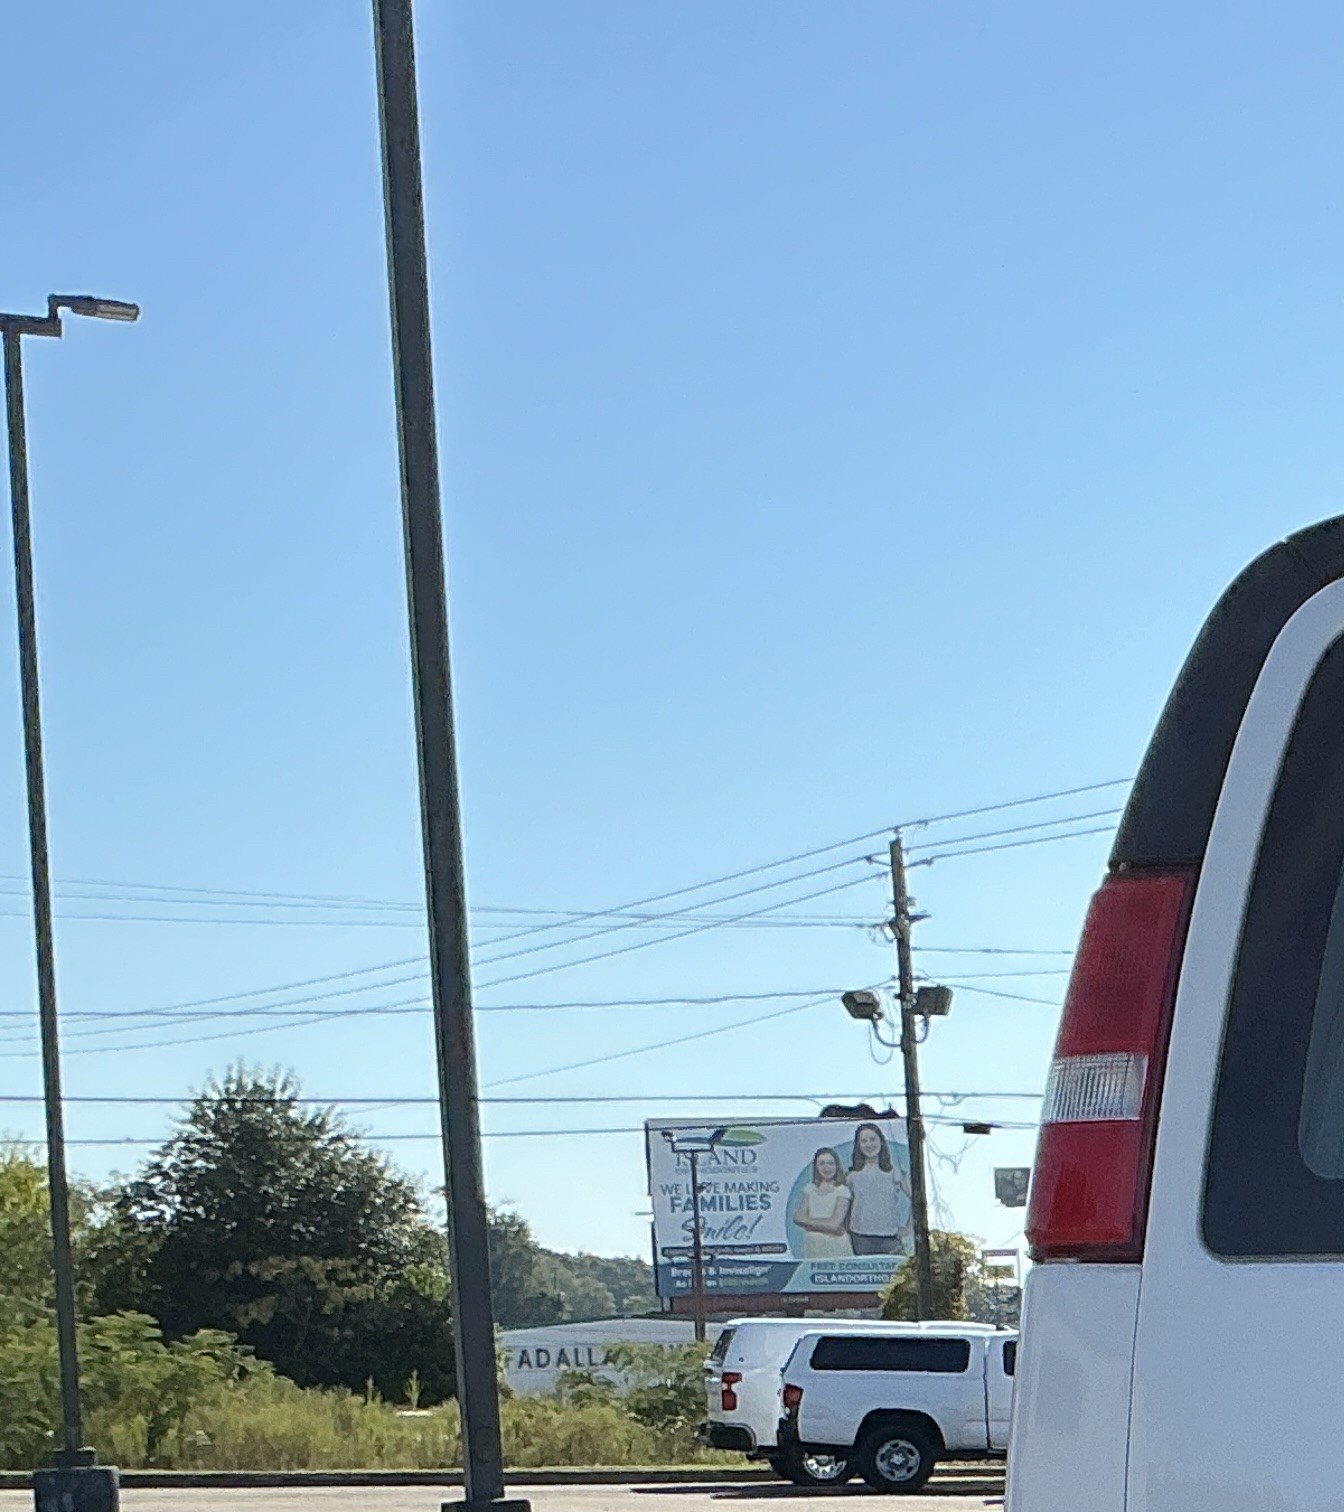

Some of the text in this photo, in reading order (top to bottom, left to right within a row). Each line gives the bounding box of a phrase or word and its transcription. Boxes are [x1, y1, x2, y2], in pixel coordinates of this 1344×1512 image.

[660, 1181, 780, 1195] WE LVE MAKING
[670, 1193, 771, 1213] FAMILIES
